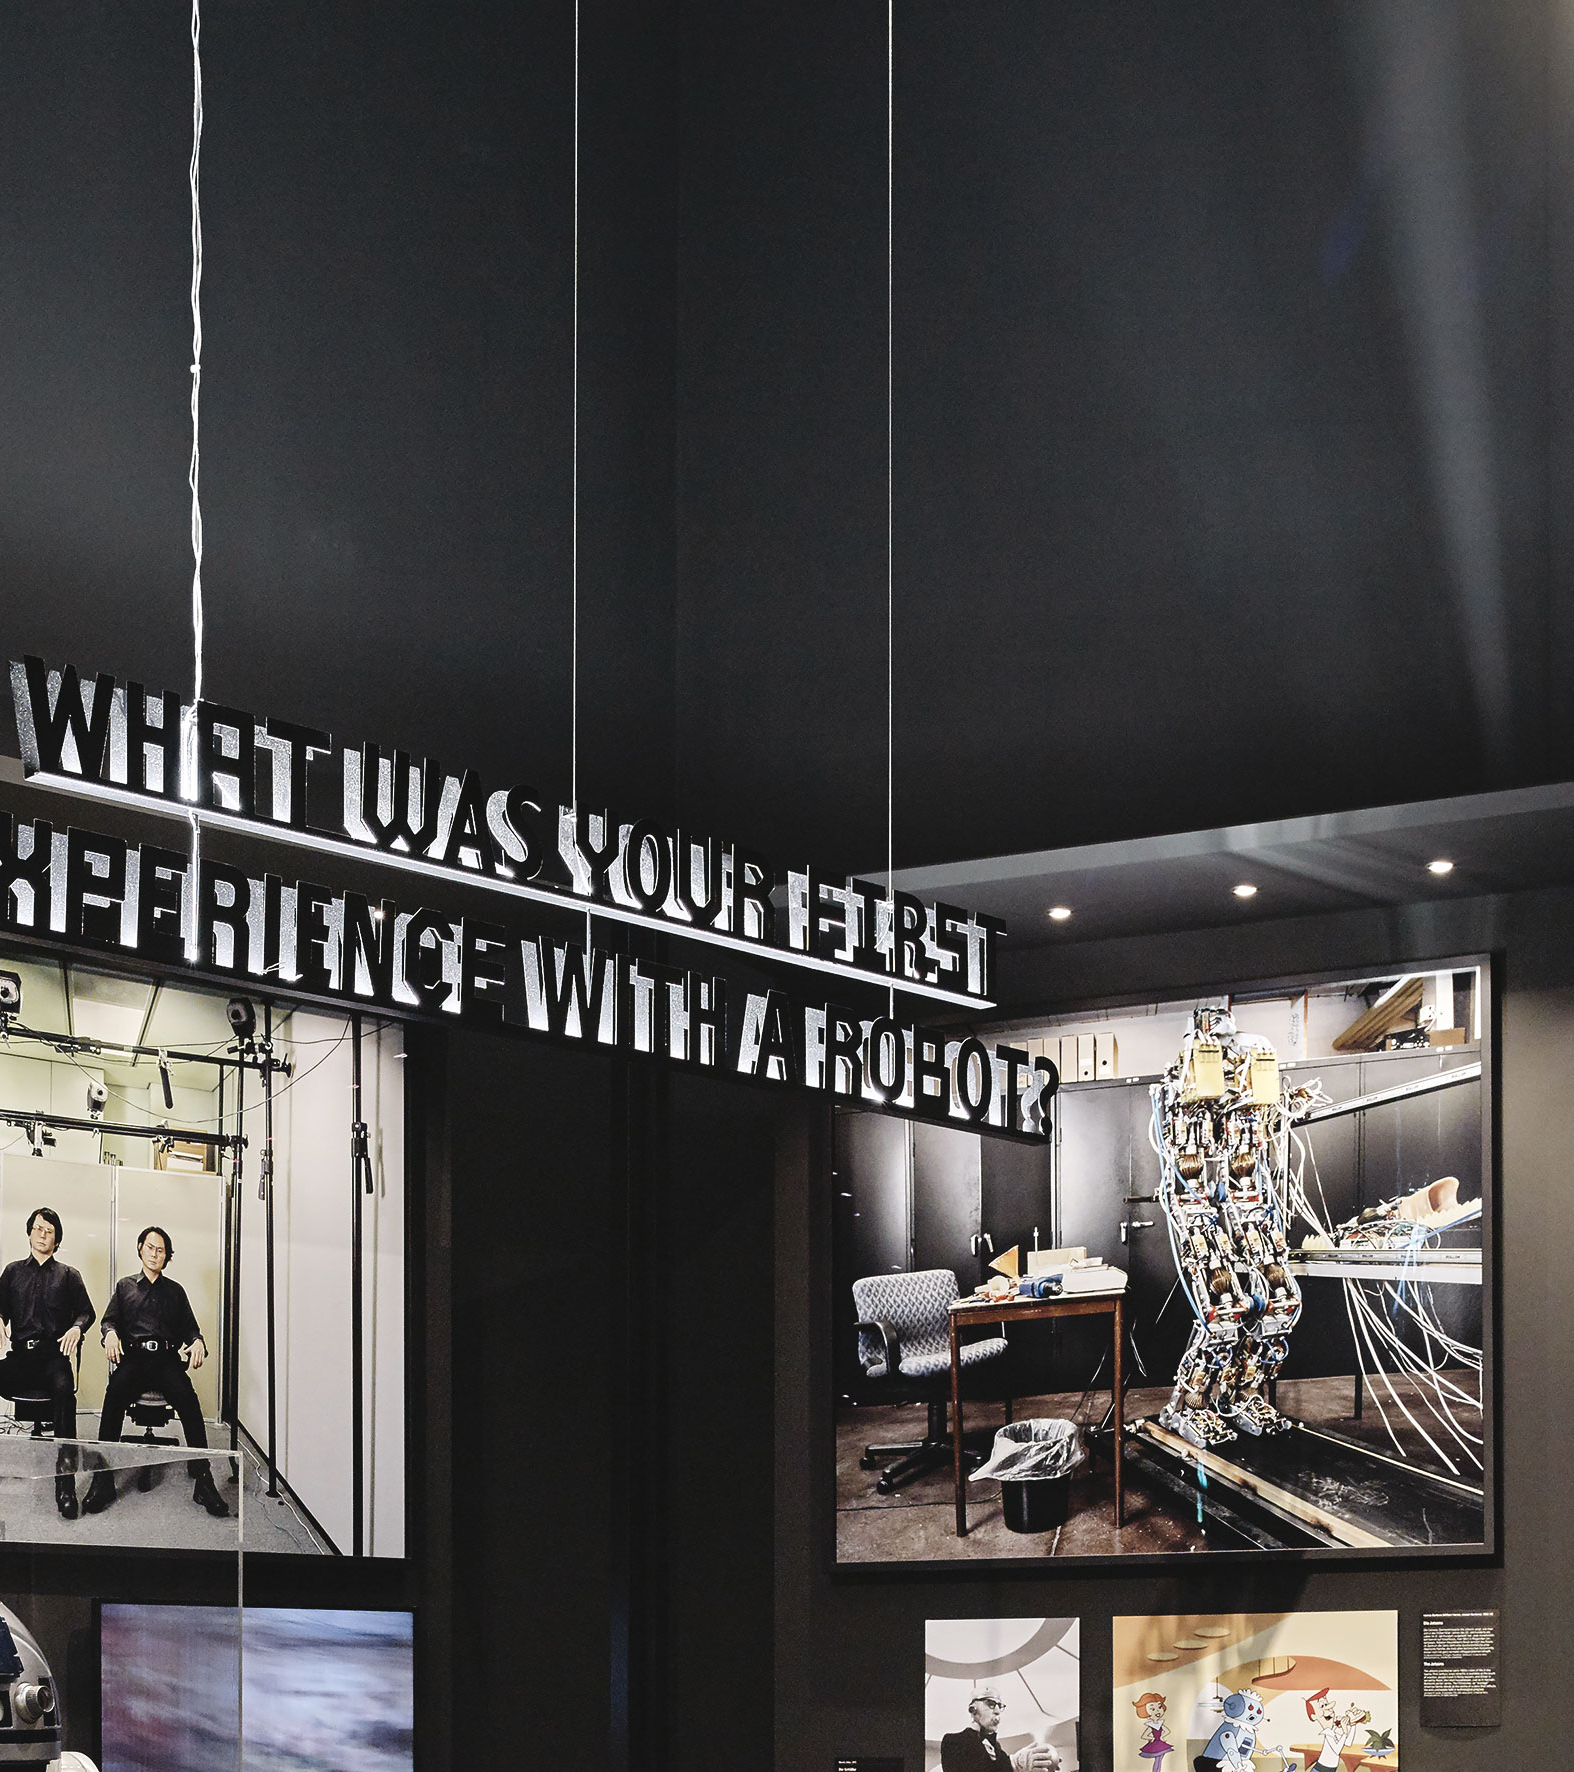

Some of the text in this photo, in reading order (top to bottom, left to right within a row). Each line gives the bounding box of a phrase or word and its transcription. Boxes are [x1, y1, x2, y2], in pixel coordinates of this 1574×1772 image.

[9, 654, 1008, 997] WHAT WAS YOUR FIRST
[521, 935, 727, 1067] WITH
[737, 989, 796, 1083] A
[804, 1002, 1060, 1137] ROBOT?
